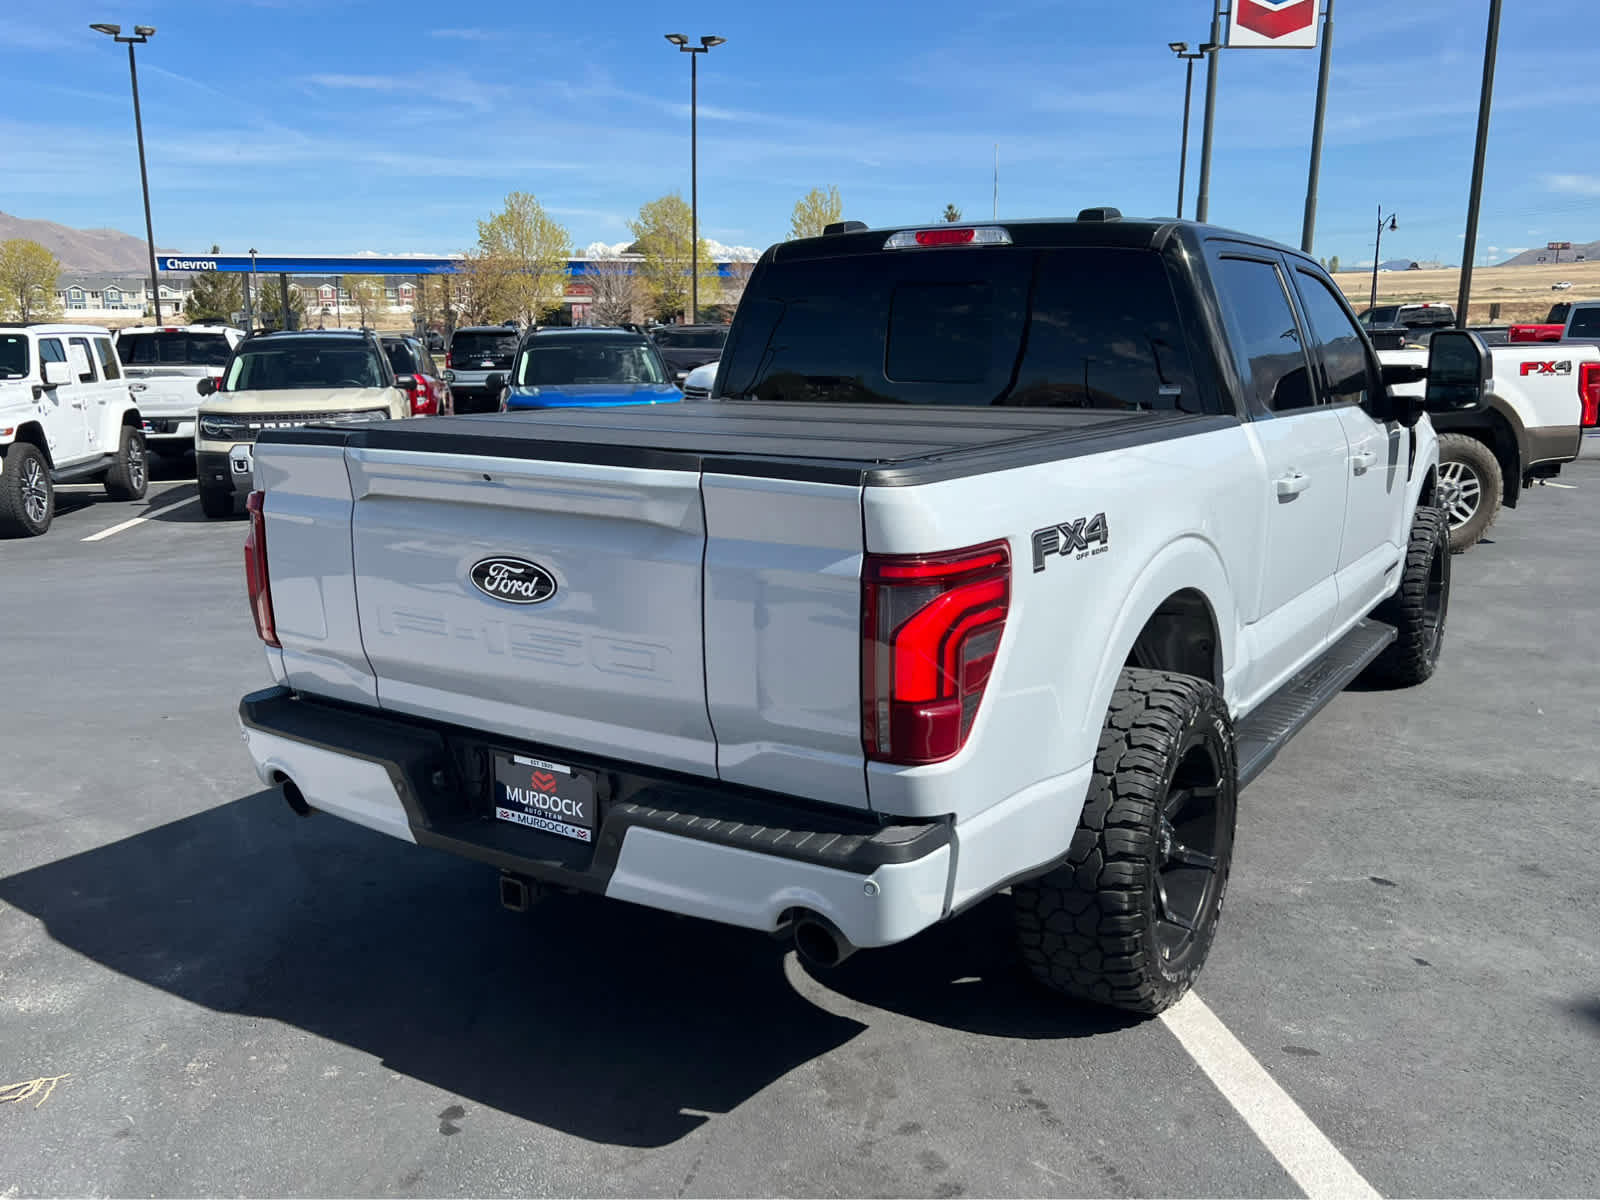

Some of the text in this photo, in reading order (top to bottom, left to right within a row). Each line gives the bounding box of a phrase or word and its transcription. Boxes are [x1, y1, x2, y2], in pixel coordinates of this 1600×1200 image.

[166, 258, 217, 270] Chevron
[1519, 360, 1572, 376] FX4
[1030, 512, 1109, 574] FX4
[485, 563, 537, 597] Ford
[505, 784, 584, 818] MURDOCK
[517, 813, 569, 835] MURDOCK
[524, 806, 563, 821] AUTO TEAM
